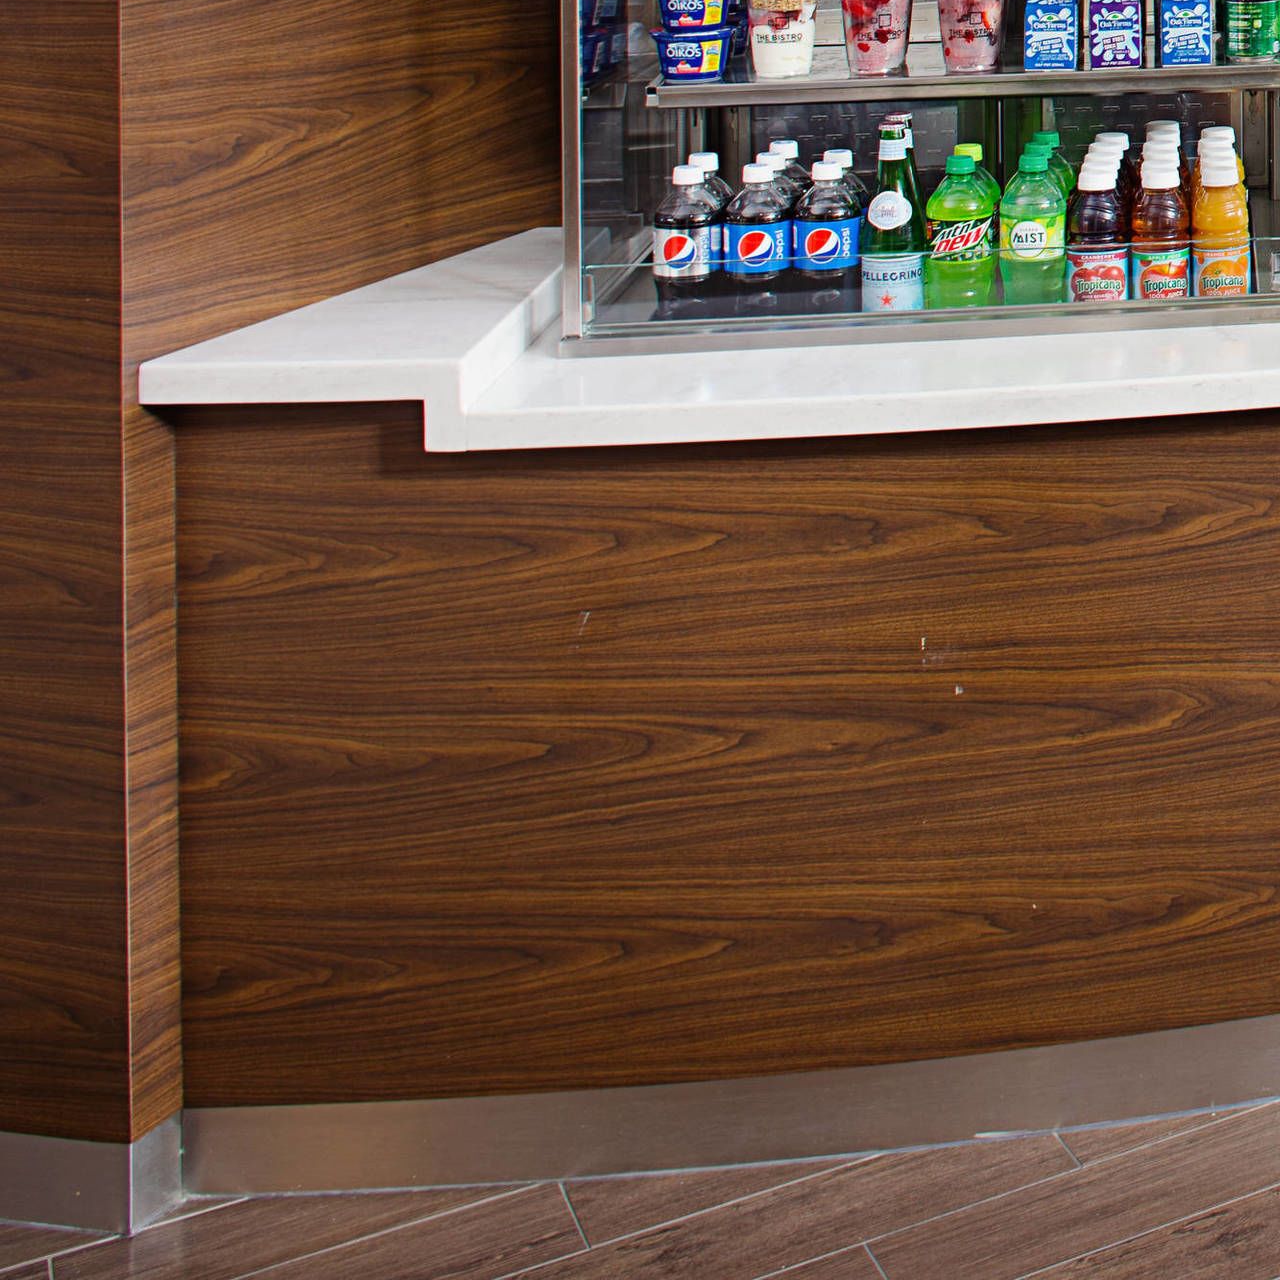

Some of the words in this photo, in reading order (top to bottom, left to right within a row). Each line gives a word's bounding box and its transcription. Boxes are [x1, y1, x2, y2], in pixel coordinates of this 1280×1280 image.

[756, 34, 769, 43] THE
[771, 33, 803, 42] BISTRO
[775, 229, 784, 260] pepsi
[841, 227, 851, 258] pepsi
[1013, 231, 1045, 244] MIST
[862, 267, 922, 282] PELLEGRINO
[1076, 279, 1121, 293] Tropicana
[1144, 277, 1187, 292] Tropicana
[1202, 276, 1244, 290] Tropicana
